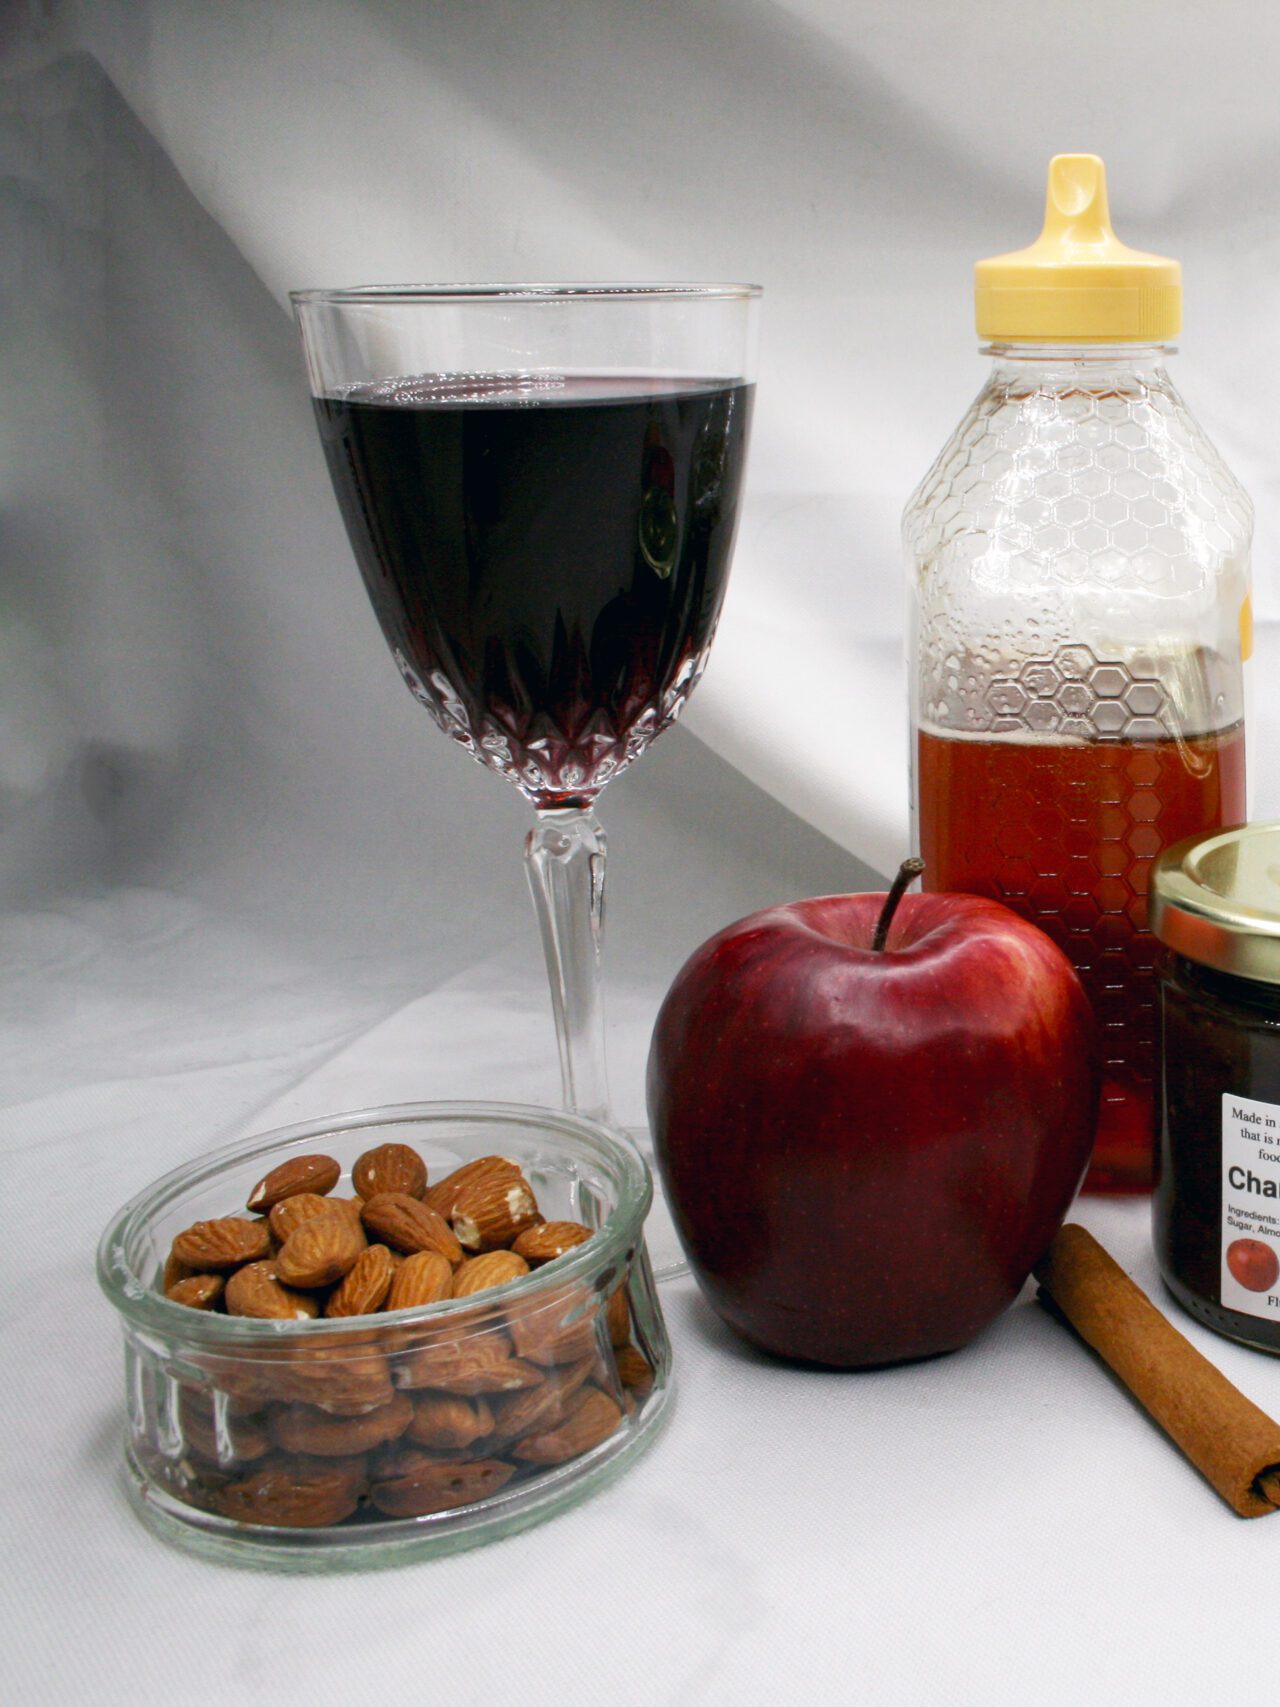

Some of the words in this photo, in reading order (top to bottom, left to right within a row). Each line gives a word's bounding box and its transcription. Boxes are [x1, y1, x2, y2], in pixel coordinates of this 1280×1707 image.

[1232, 1107, 1262, 1125] Made
[1265, 1115, 1276, 1128] in
[1240, 1128, 1260, 1142] that
[1264, 1132, 1274, 1144] is
[1227, 1203, 1280, 1225] Ingredients:
[1226, 1216, 1255, 1234] Sugar,
